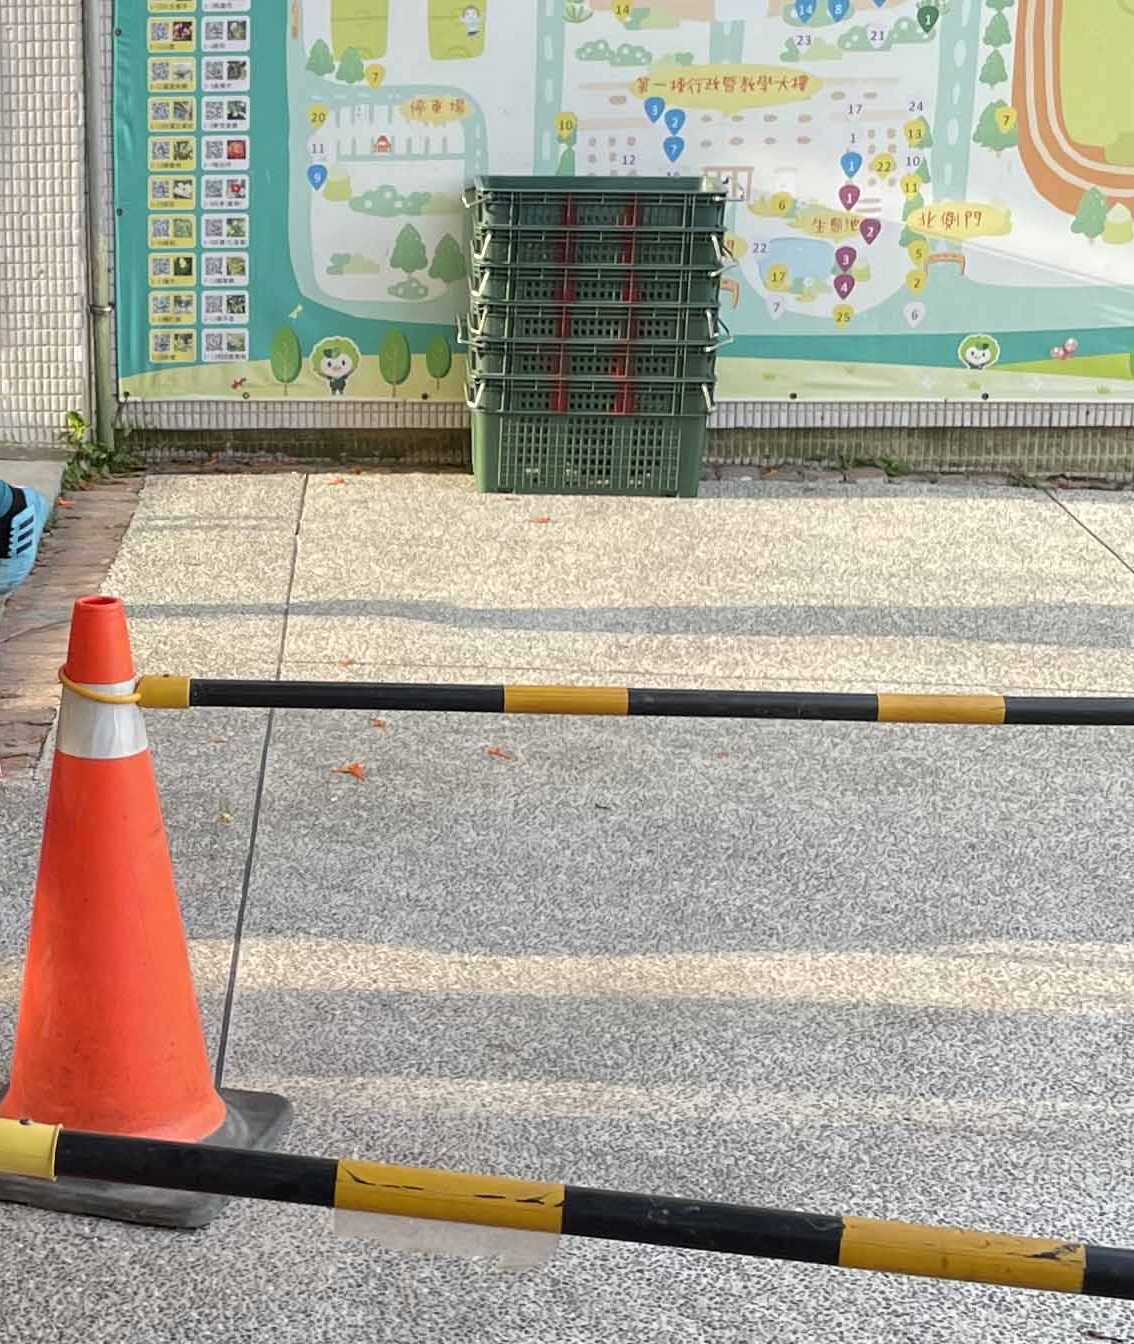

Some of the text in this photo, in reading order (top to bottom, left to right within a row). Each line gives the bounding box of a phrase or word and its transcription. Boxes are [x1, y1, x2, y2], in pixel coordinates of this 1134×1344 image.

[616, 4, 630, 15] 14
[799, 3, 813, 15] 14
[797, 35, 811, 46] 23
[870, 30, 884, 42] 21
[848, 104, 862, 115] 17
[909, 101, 923, 112] 24
[311, 112, 326, 123] 20
[559, 119, 573, 131] 10
[908, 128, 922, 140] 13
[312, 144, 324, 155] 11
[623, 155, 636, 166] 12
[906, 156, 920, 167] 10
[877, 161, 891, 173] 22
[753, 242, 767, 254] 22
[772, 271, 785, 282] 17
[836, 311, 851, 323] 25
